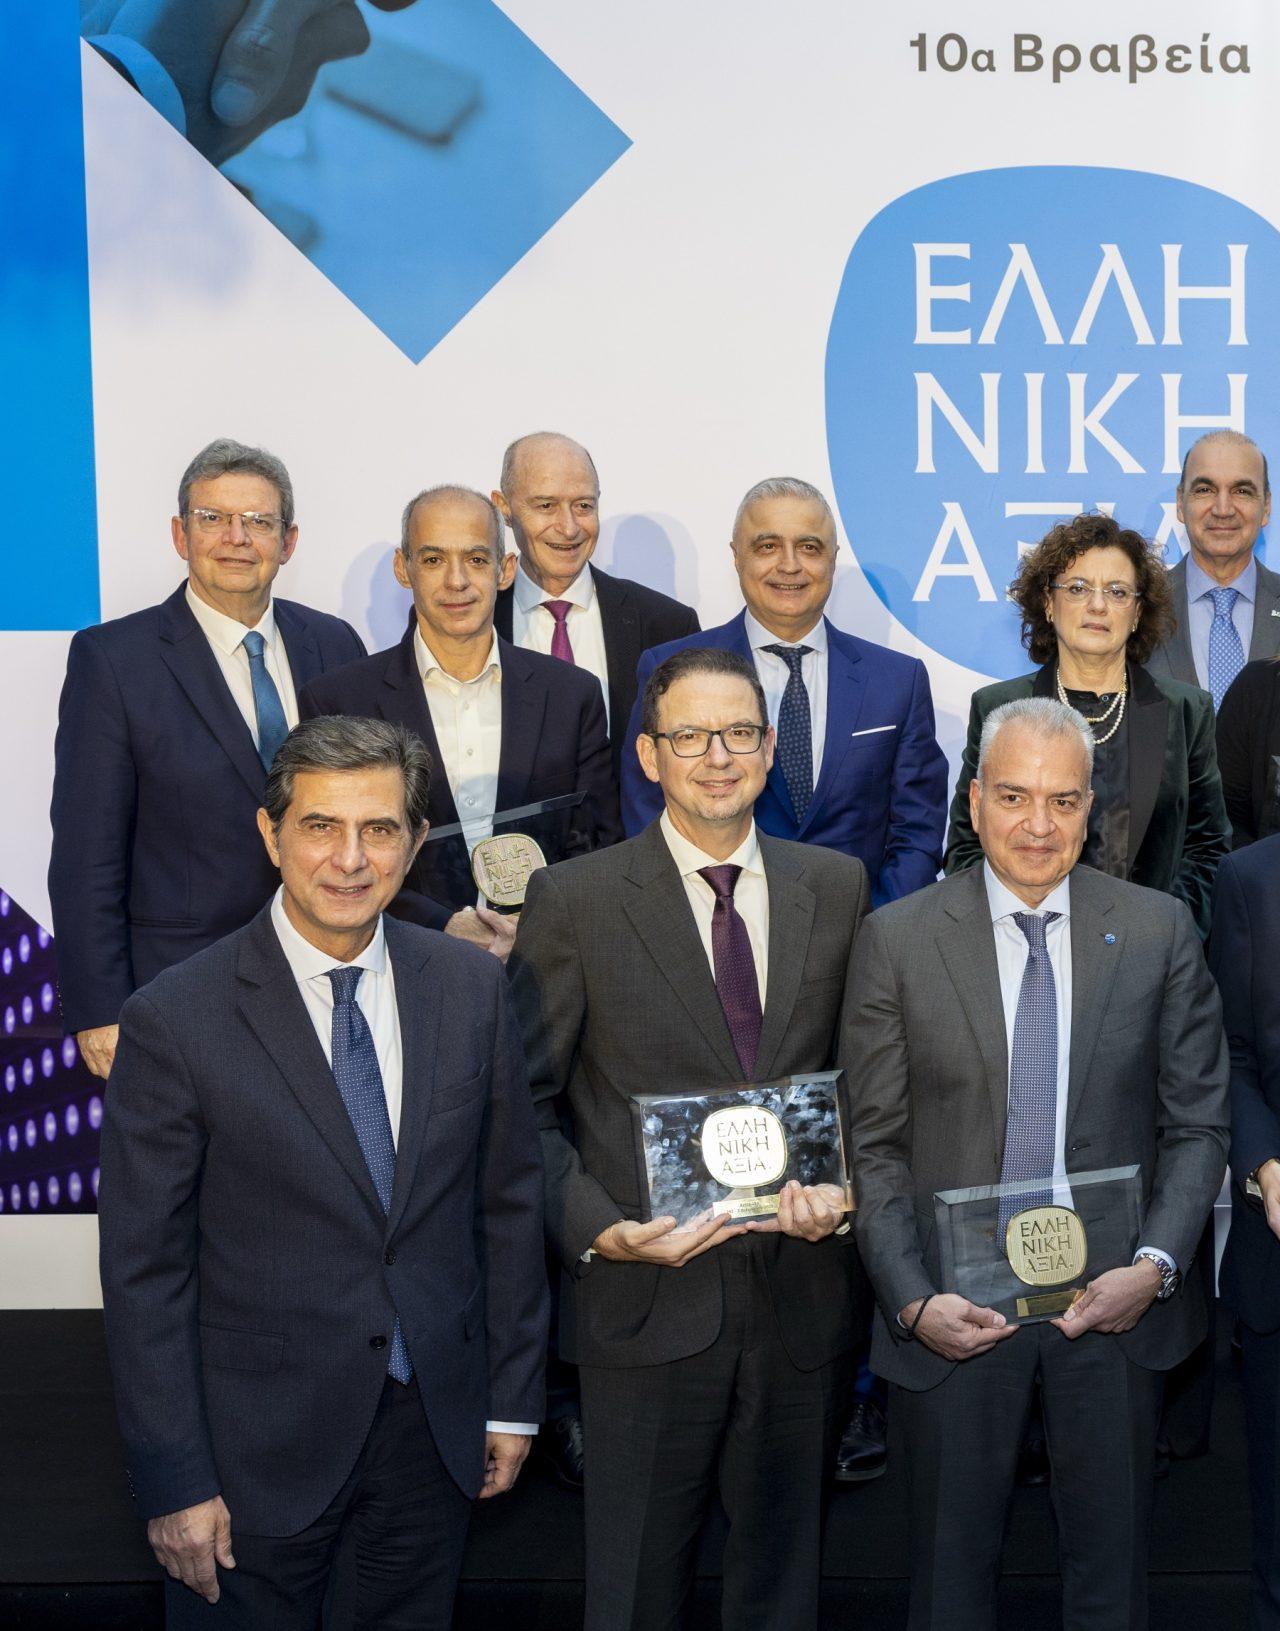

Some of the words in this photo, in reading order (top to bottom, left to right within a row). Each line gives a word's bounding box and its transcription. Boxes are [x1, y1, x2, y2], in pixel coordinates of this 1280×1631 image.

[1014, 33, 1250, 83] Βραβεία
[913, 243, 1249, 345] ΕΛΛΗ
[913, 373, 1247, 473] ΝΙΚΗ
[717, 1117, 768, 1137] ΕΛΛΗ
[719, 1136, 769, 1156] ΝΙΚΗ
[1020, 1216, 1069, 1237] ΕΛΛΗ
[1022, 1234, 1072, 1255] ΝΙΚΗ
